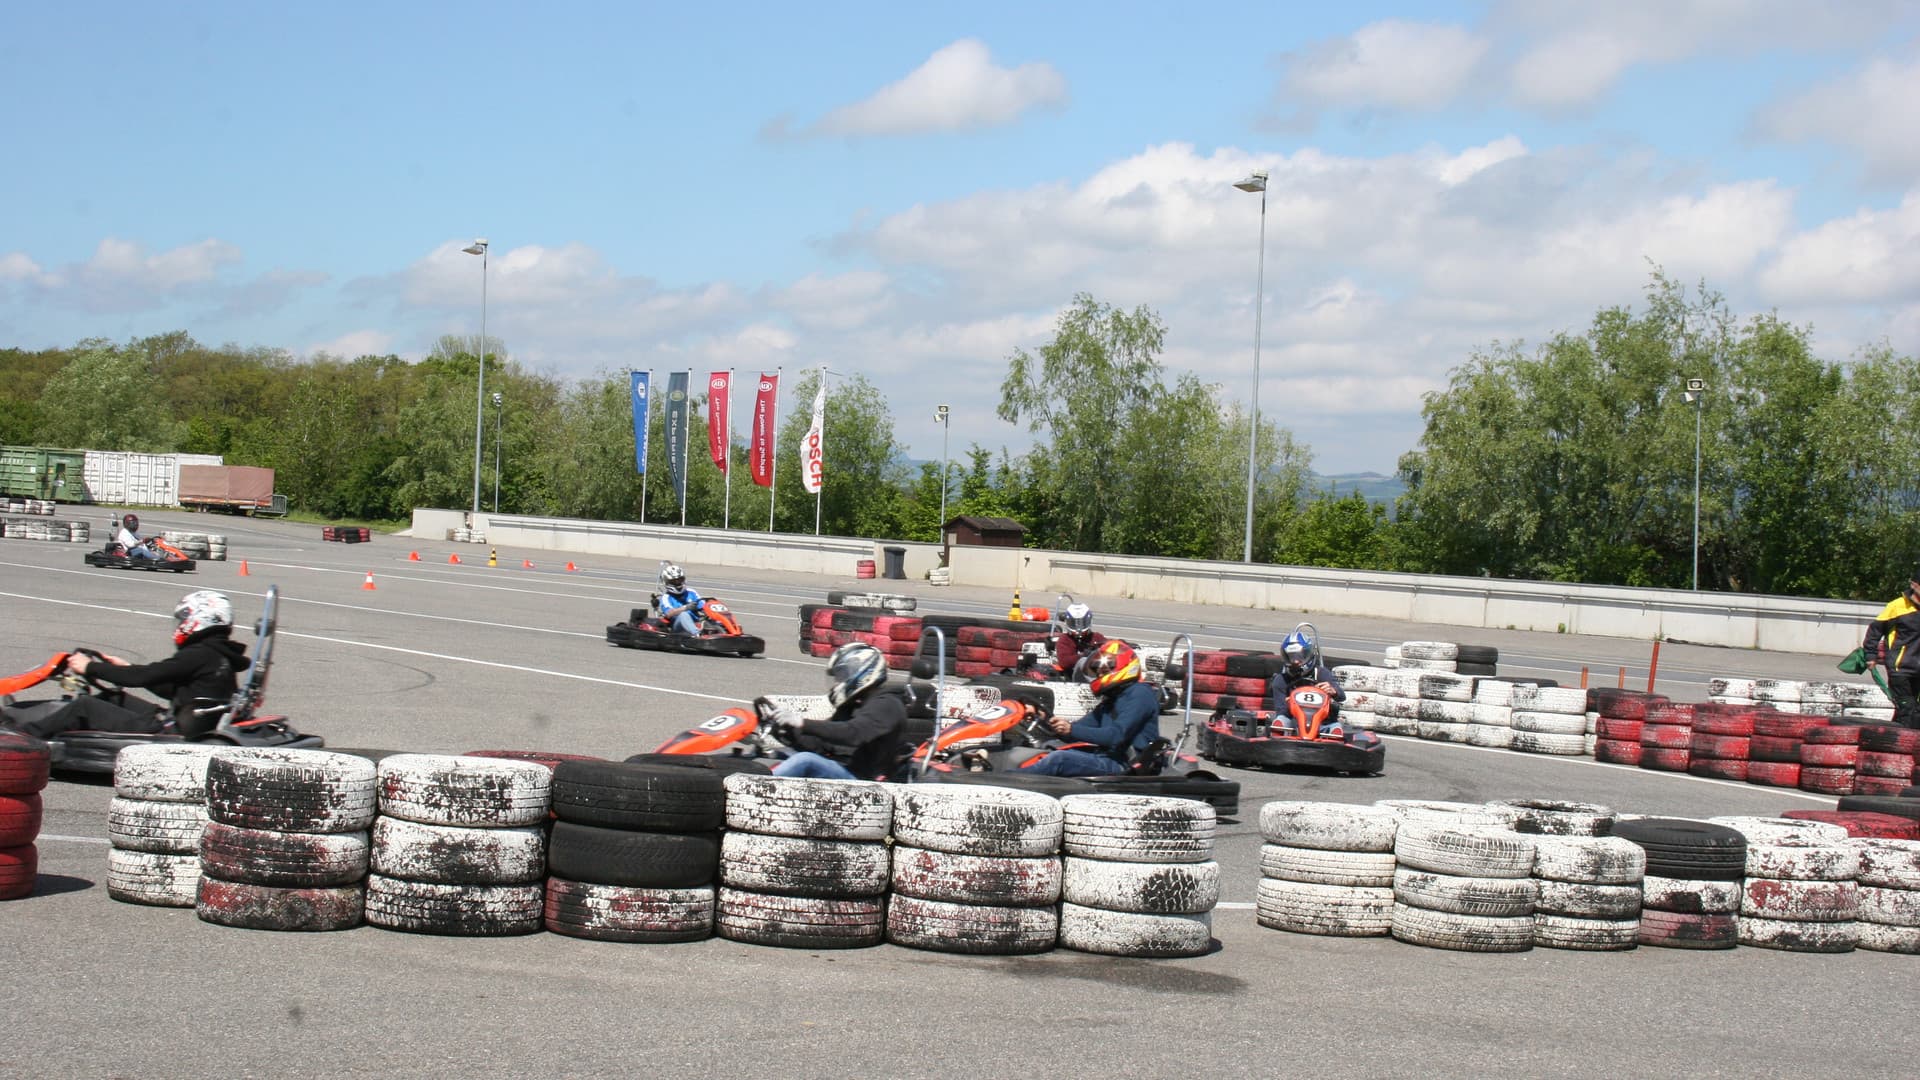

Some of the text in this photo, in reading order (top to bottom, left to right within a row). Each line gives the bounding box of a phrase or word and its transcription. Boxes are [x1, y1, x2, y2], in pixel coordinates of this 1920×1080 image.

[809, 432, 823, 487] OSCH
[1303, 693, 1315, 703] 8
[705, 716, 728, 727] 9
